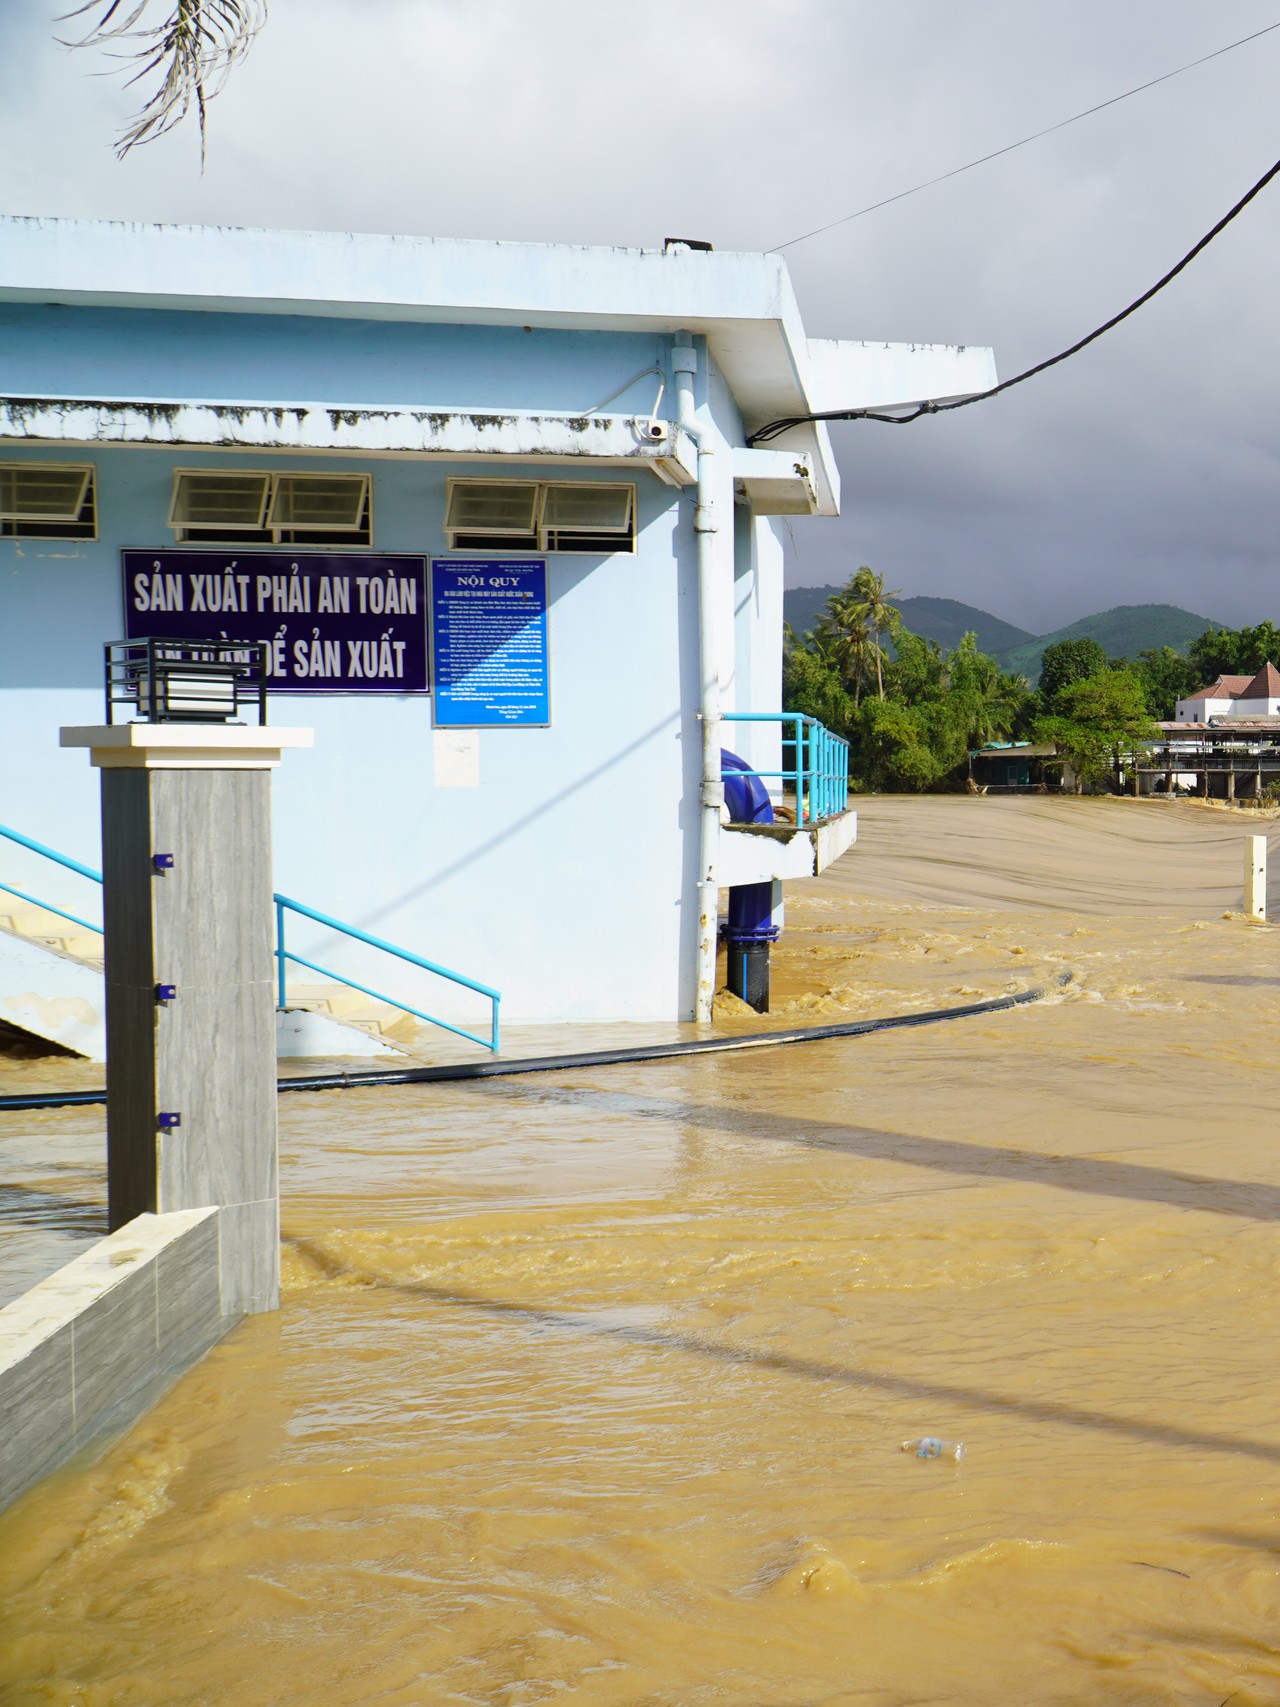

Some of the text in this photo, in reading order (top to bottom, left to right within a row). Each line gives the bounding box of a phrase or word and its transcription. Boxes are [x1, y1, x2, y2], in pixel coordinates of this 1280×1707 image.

[134, 561, 417, 615] SẢN XUẤT PHẢI AN TOÀN
[457, 575, 520, 588] NỘI QUY
[294, 627, 341, 678] SẢN
[348, 627, 407, 679] XUẤT
